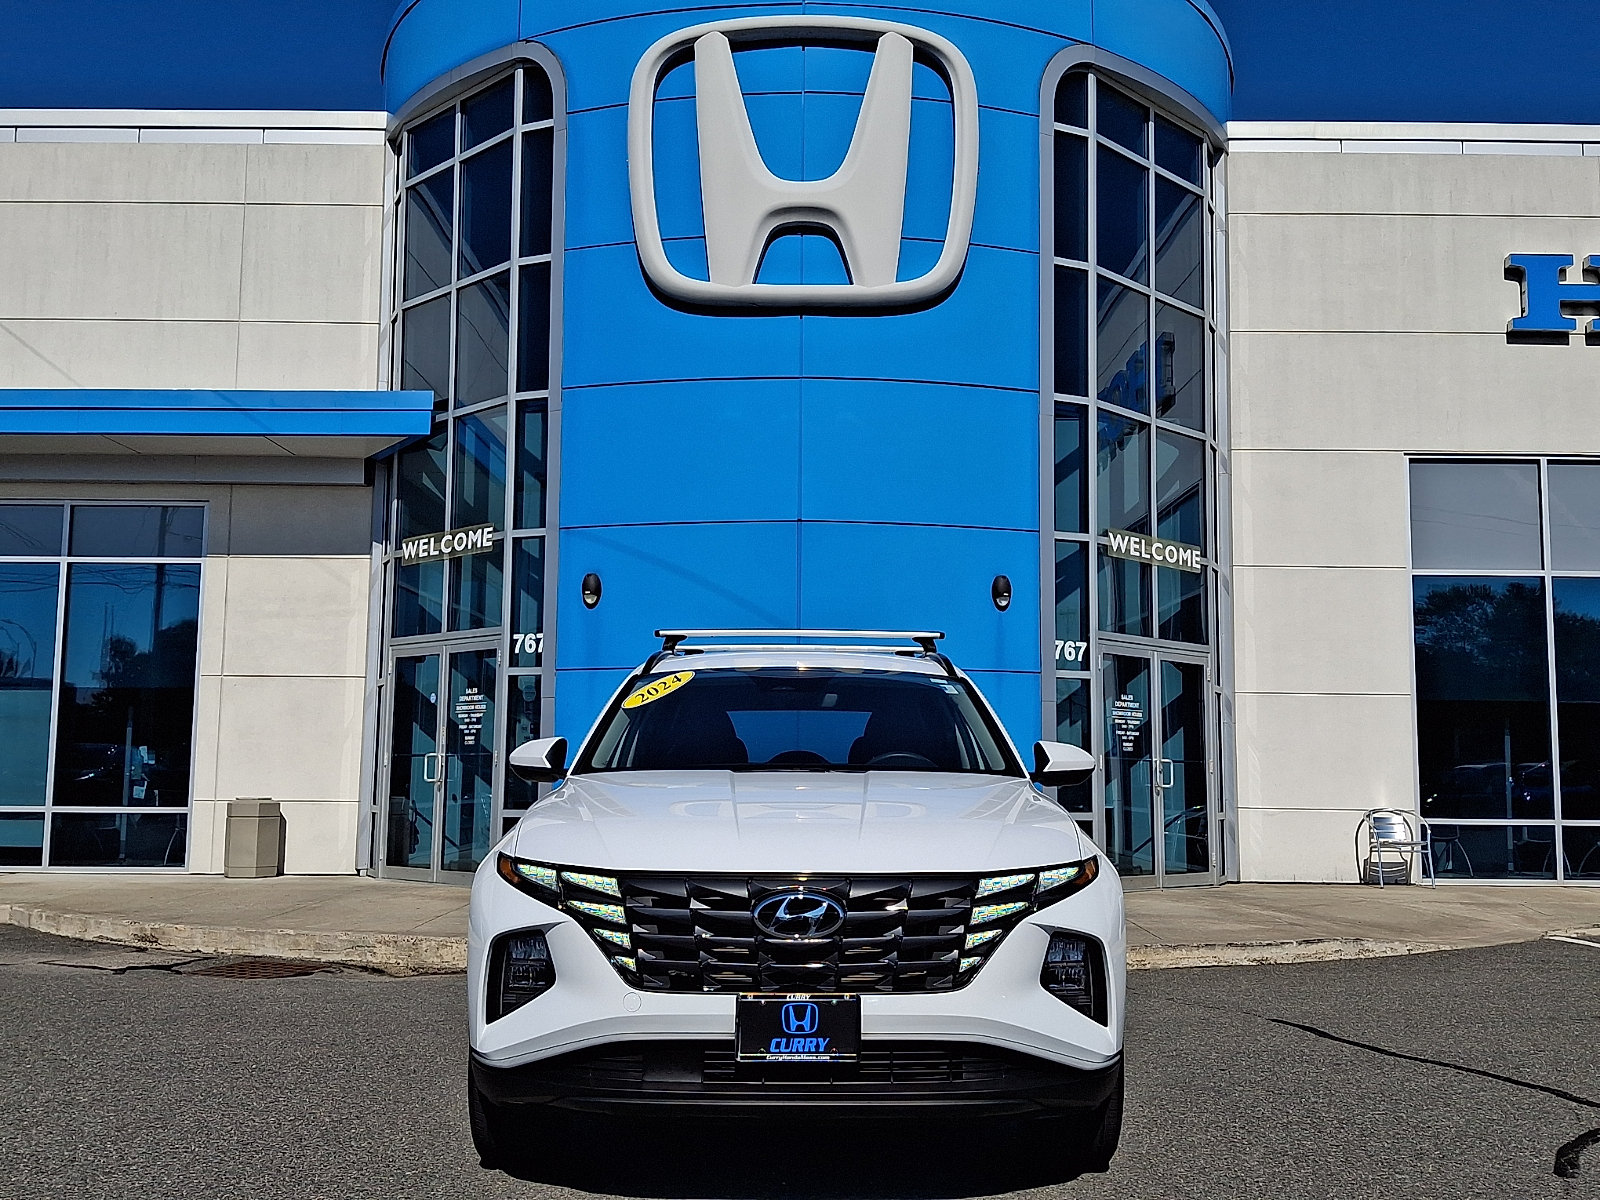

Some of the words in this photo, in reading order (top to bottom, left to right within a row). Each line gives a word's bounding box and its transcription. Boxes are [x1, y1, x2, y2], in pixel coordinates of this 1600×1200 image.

[402, 527, 494, 560] WELCOME
[1108, 531, 1201, 569] WELCOME
[1055, 640, 1088, 662] 767
[634, 675, 682, 703] 2024
[770, 1037, 830, 1053] CURRY
